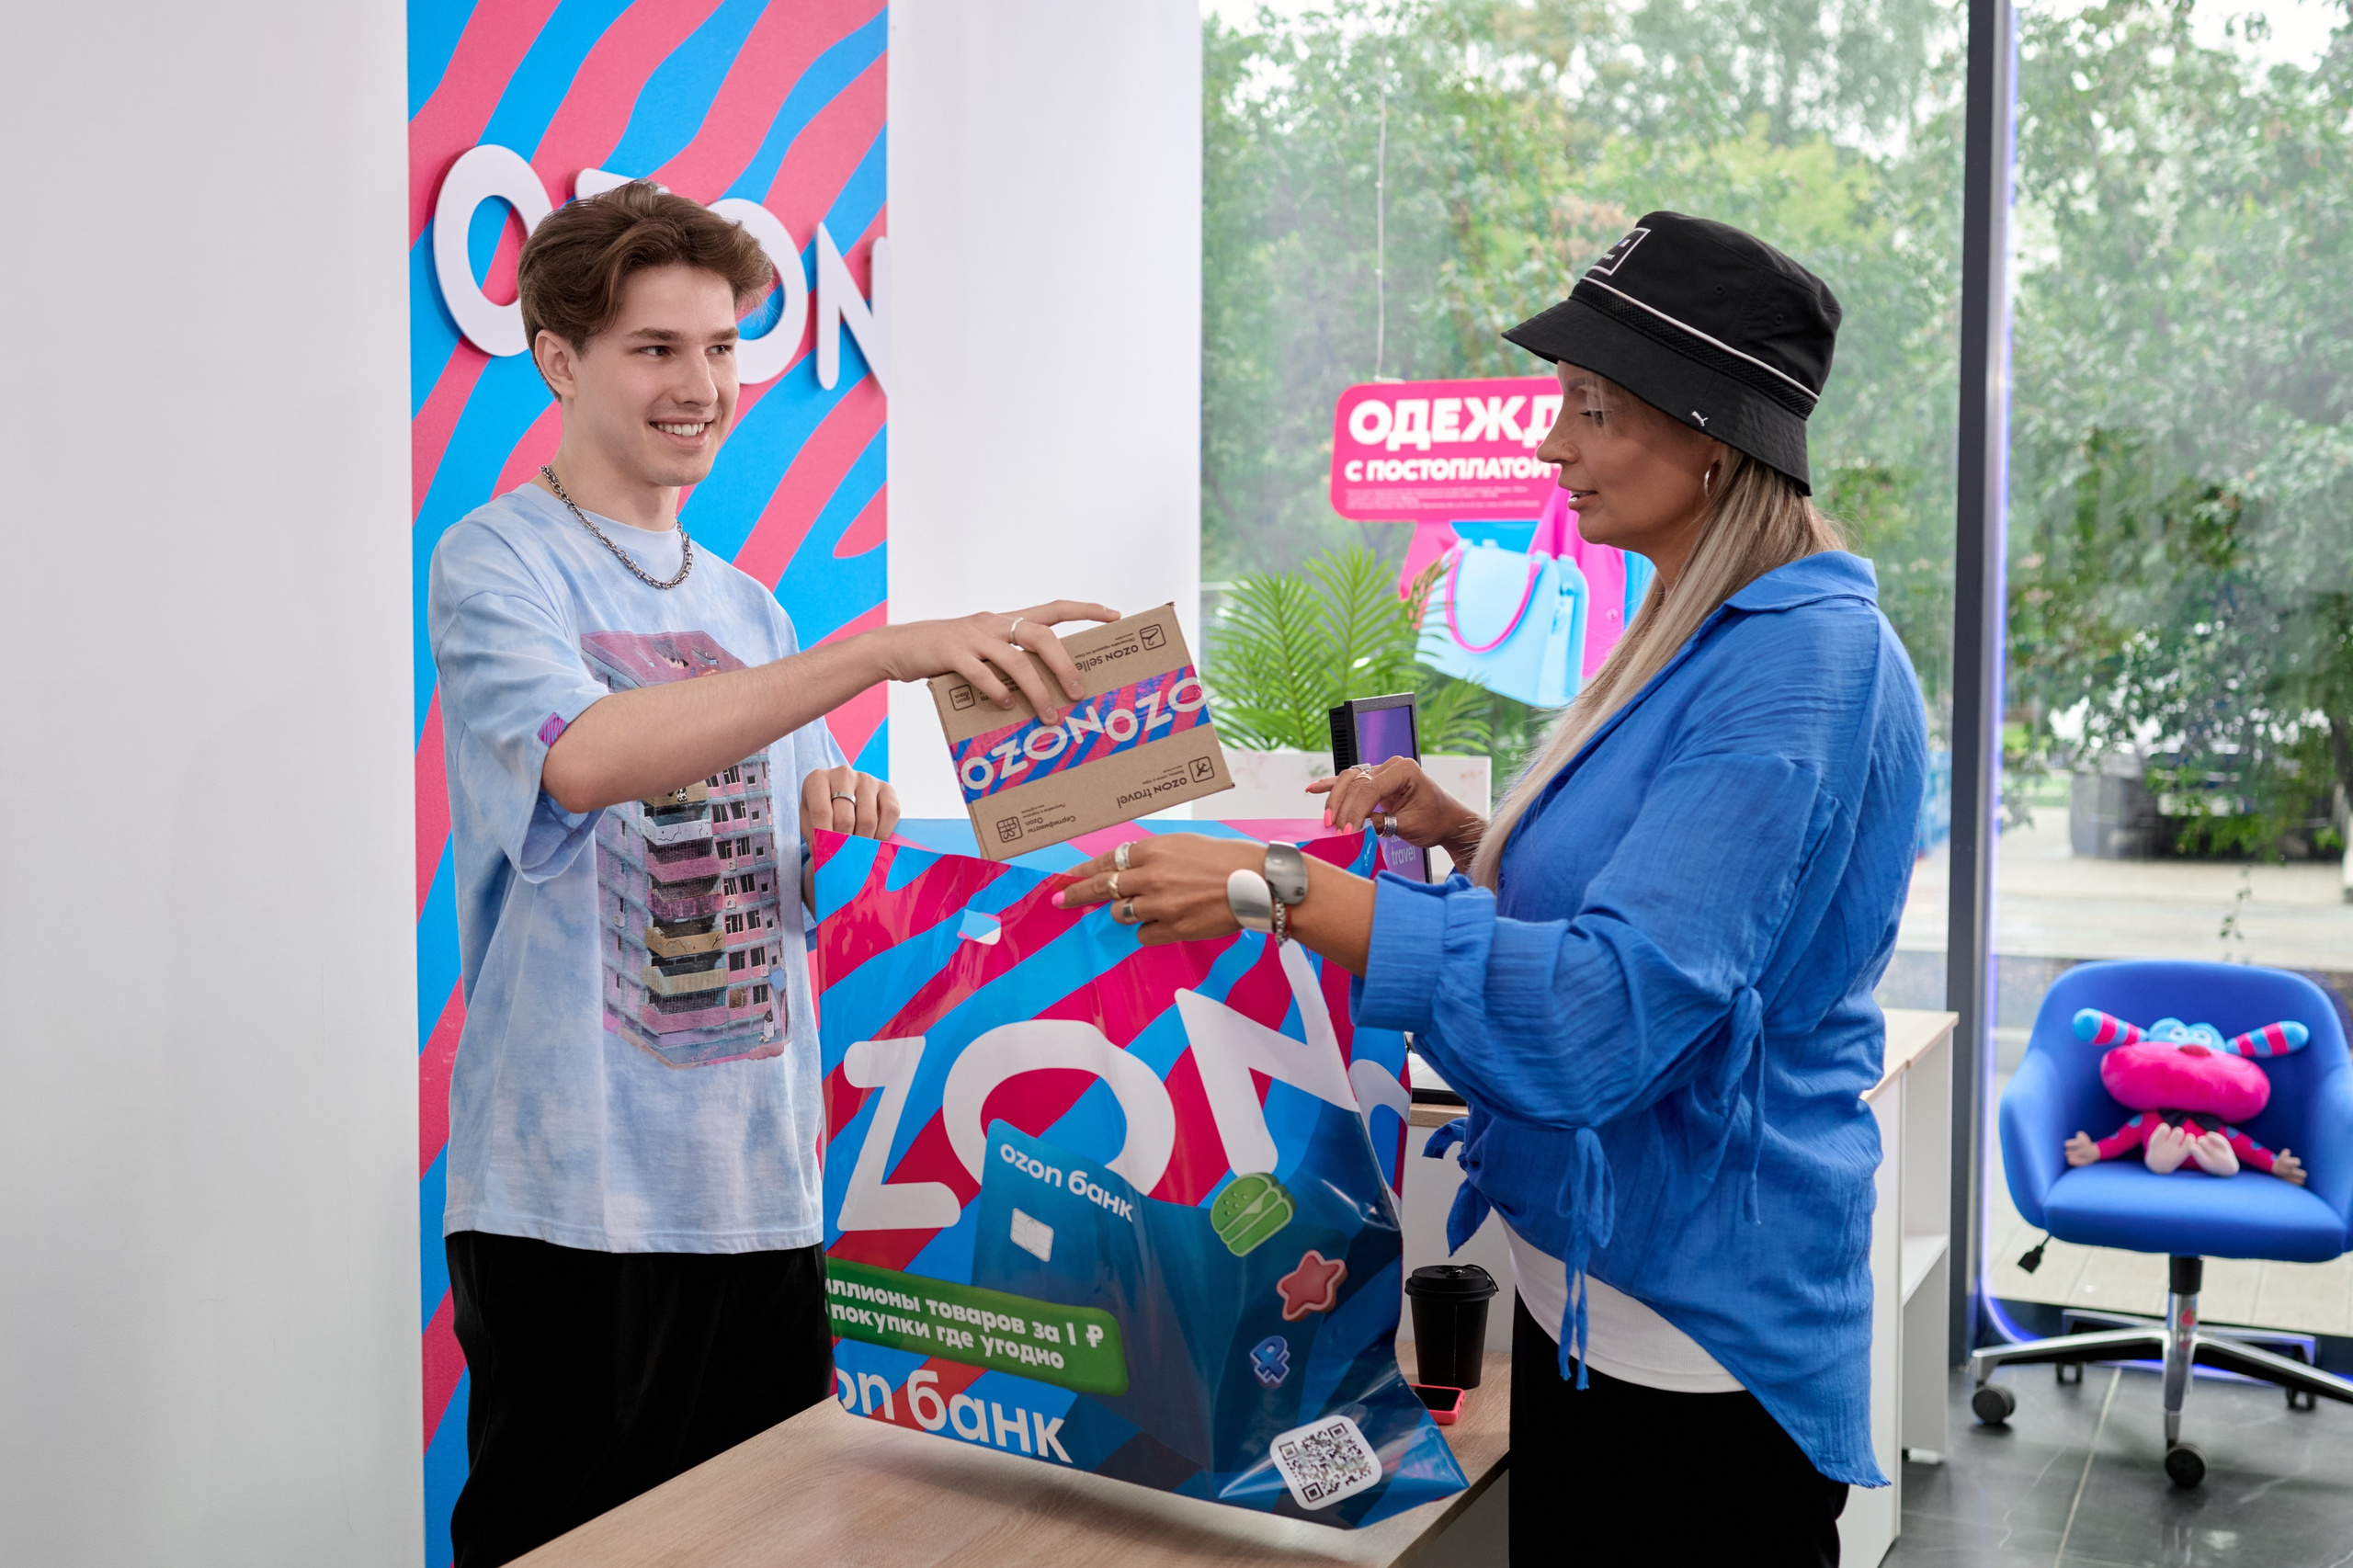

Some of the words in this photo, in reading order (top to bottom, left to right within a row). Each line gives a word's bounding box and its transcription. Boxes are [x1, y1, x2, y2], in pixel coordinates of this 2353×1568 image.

[433, 143, 888, 395] OON
[1345, 460, 1364, 482] С
[1105, 645, 1139, 661] OZON
[1154, 778, 1187, 793] OZON
[1117, 789, 1152, 808] travel
[1025, 817, 1043, 826] Ozon
[1028, 815, 1075, 834] Сертификаты
[1391, 845, 1416, 867] travel
[1000, 1143, 1063, 1188] ozon
[1068, 1169, 1133, 1222] банк
[926, 1299, 1026, 1334] товаров
[1031, 1322, 1061, 1344] за
[830, 1302, 930, 1339] покупки
[936, 1324, 974, 1349] где
[980, 1334, 1065, 1369] угодно
[906, 1369, 1074, 1464] банк
